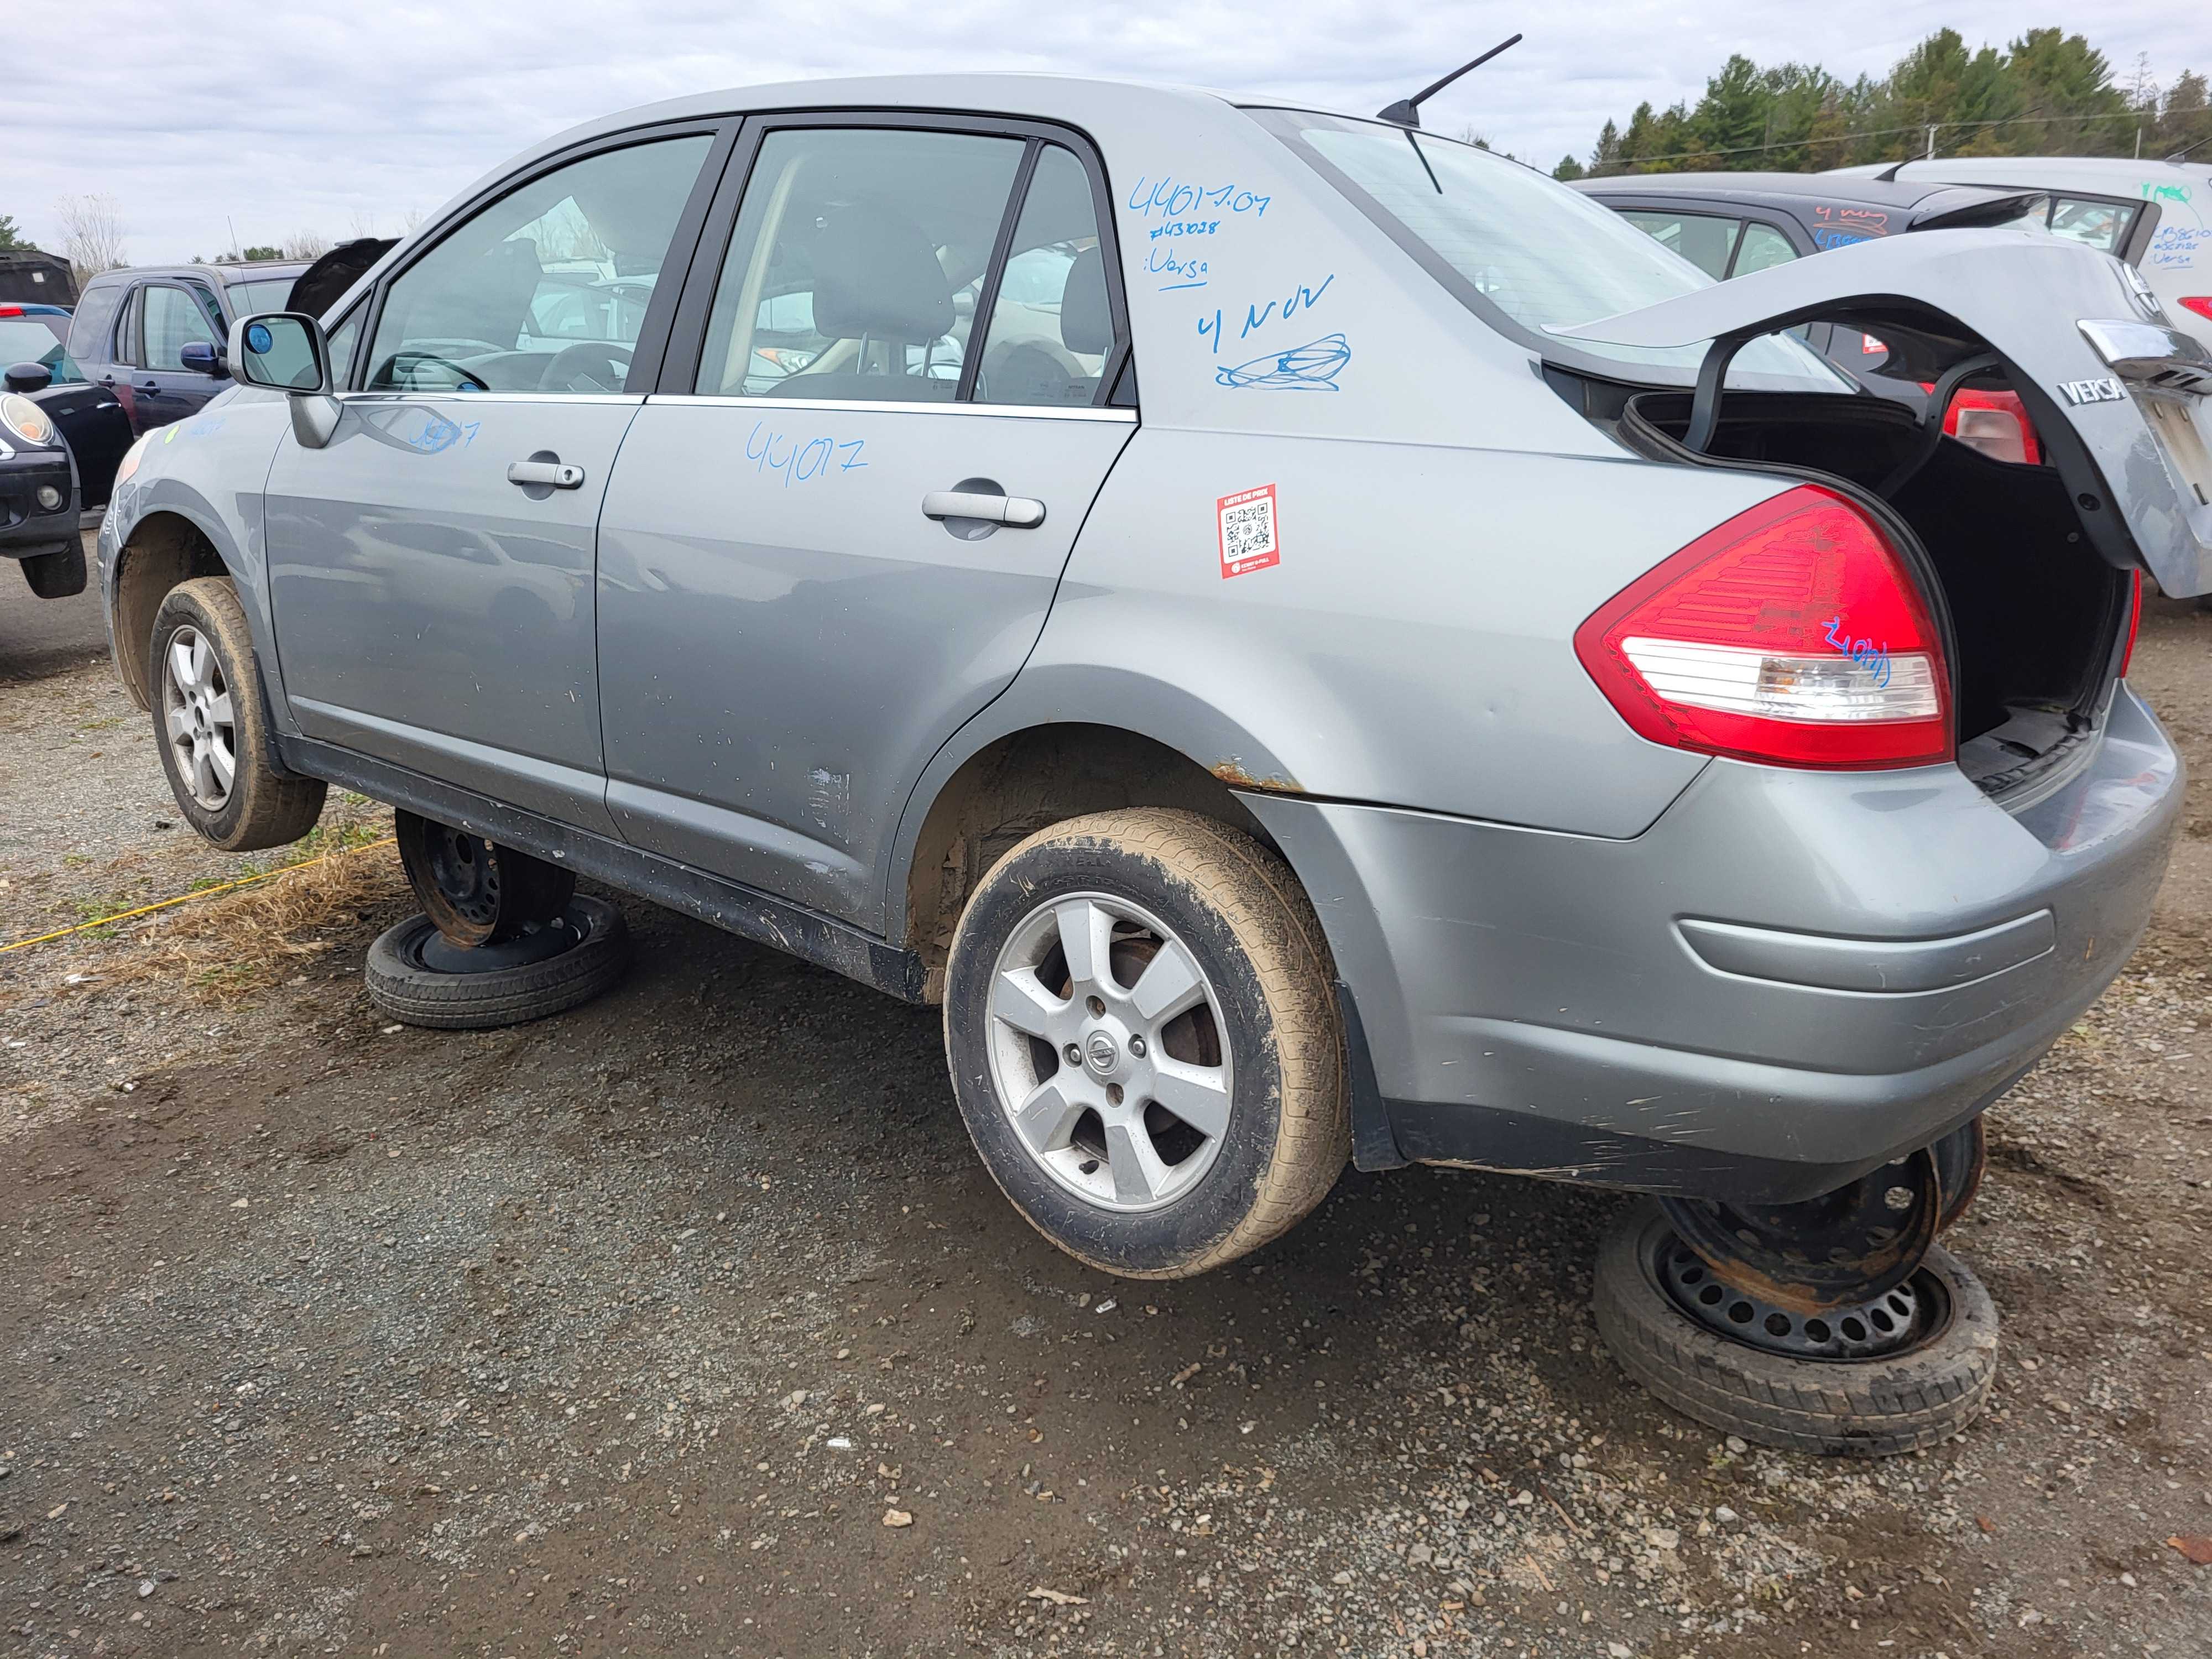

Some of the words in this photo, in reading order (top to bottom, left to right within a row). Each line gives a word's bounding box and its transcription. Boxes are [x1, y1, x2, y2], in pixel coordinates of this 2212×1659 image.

[2057, 378, 2127, 405] VERSA
[747, 420, 869, 488] 44017
[1224, 495, 1242, 506] LISTE
[1242, 492, 1252, 500] DE
[1252, 487, 1268, 498] PRIX
